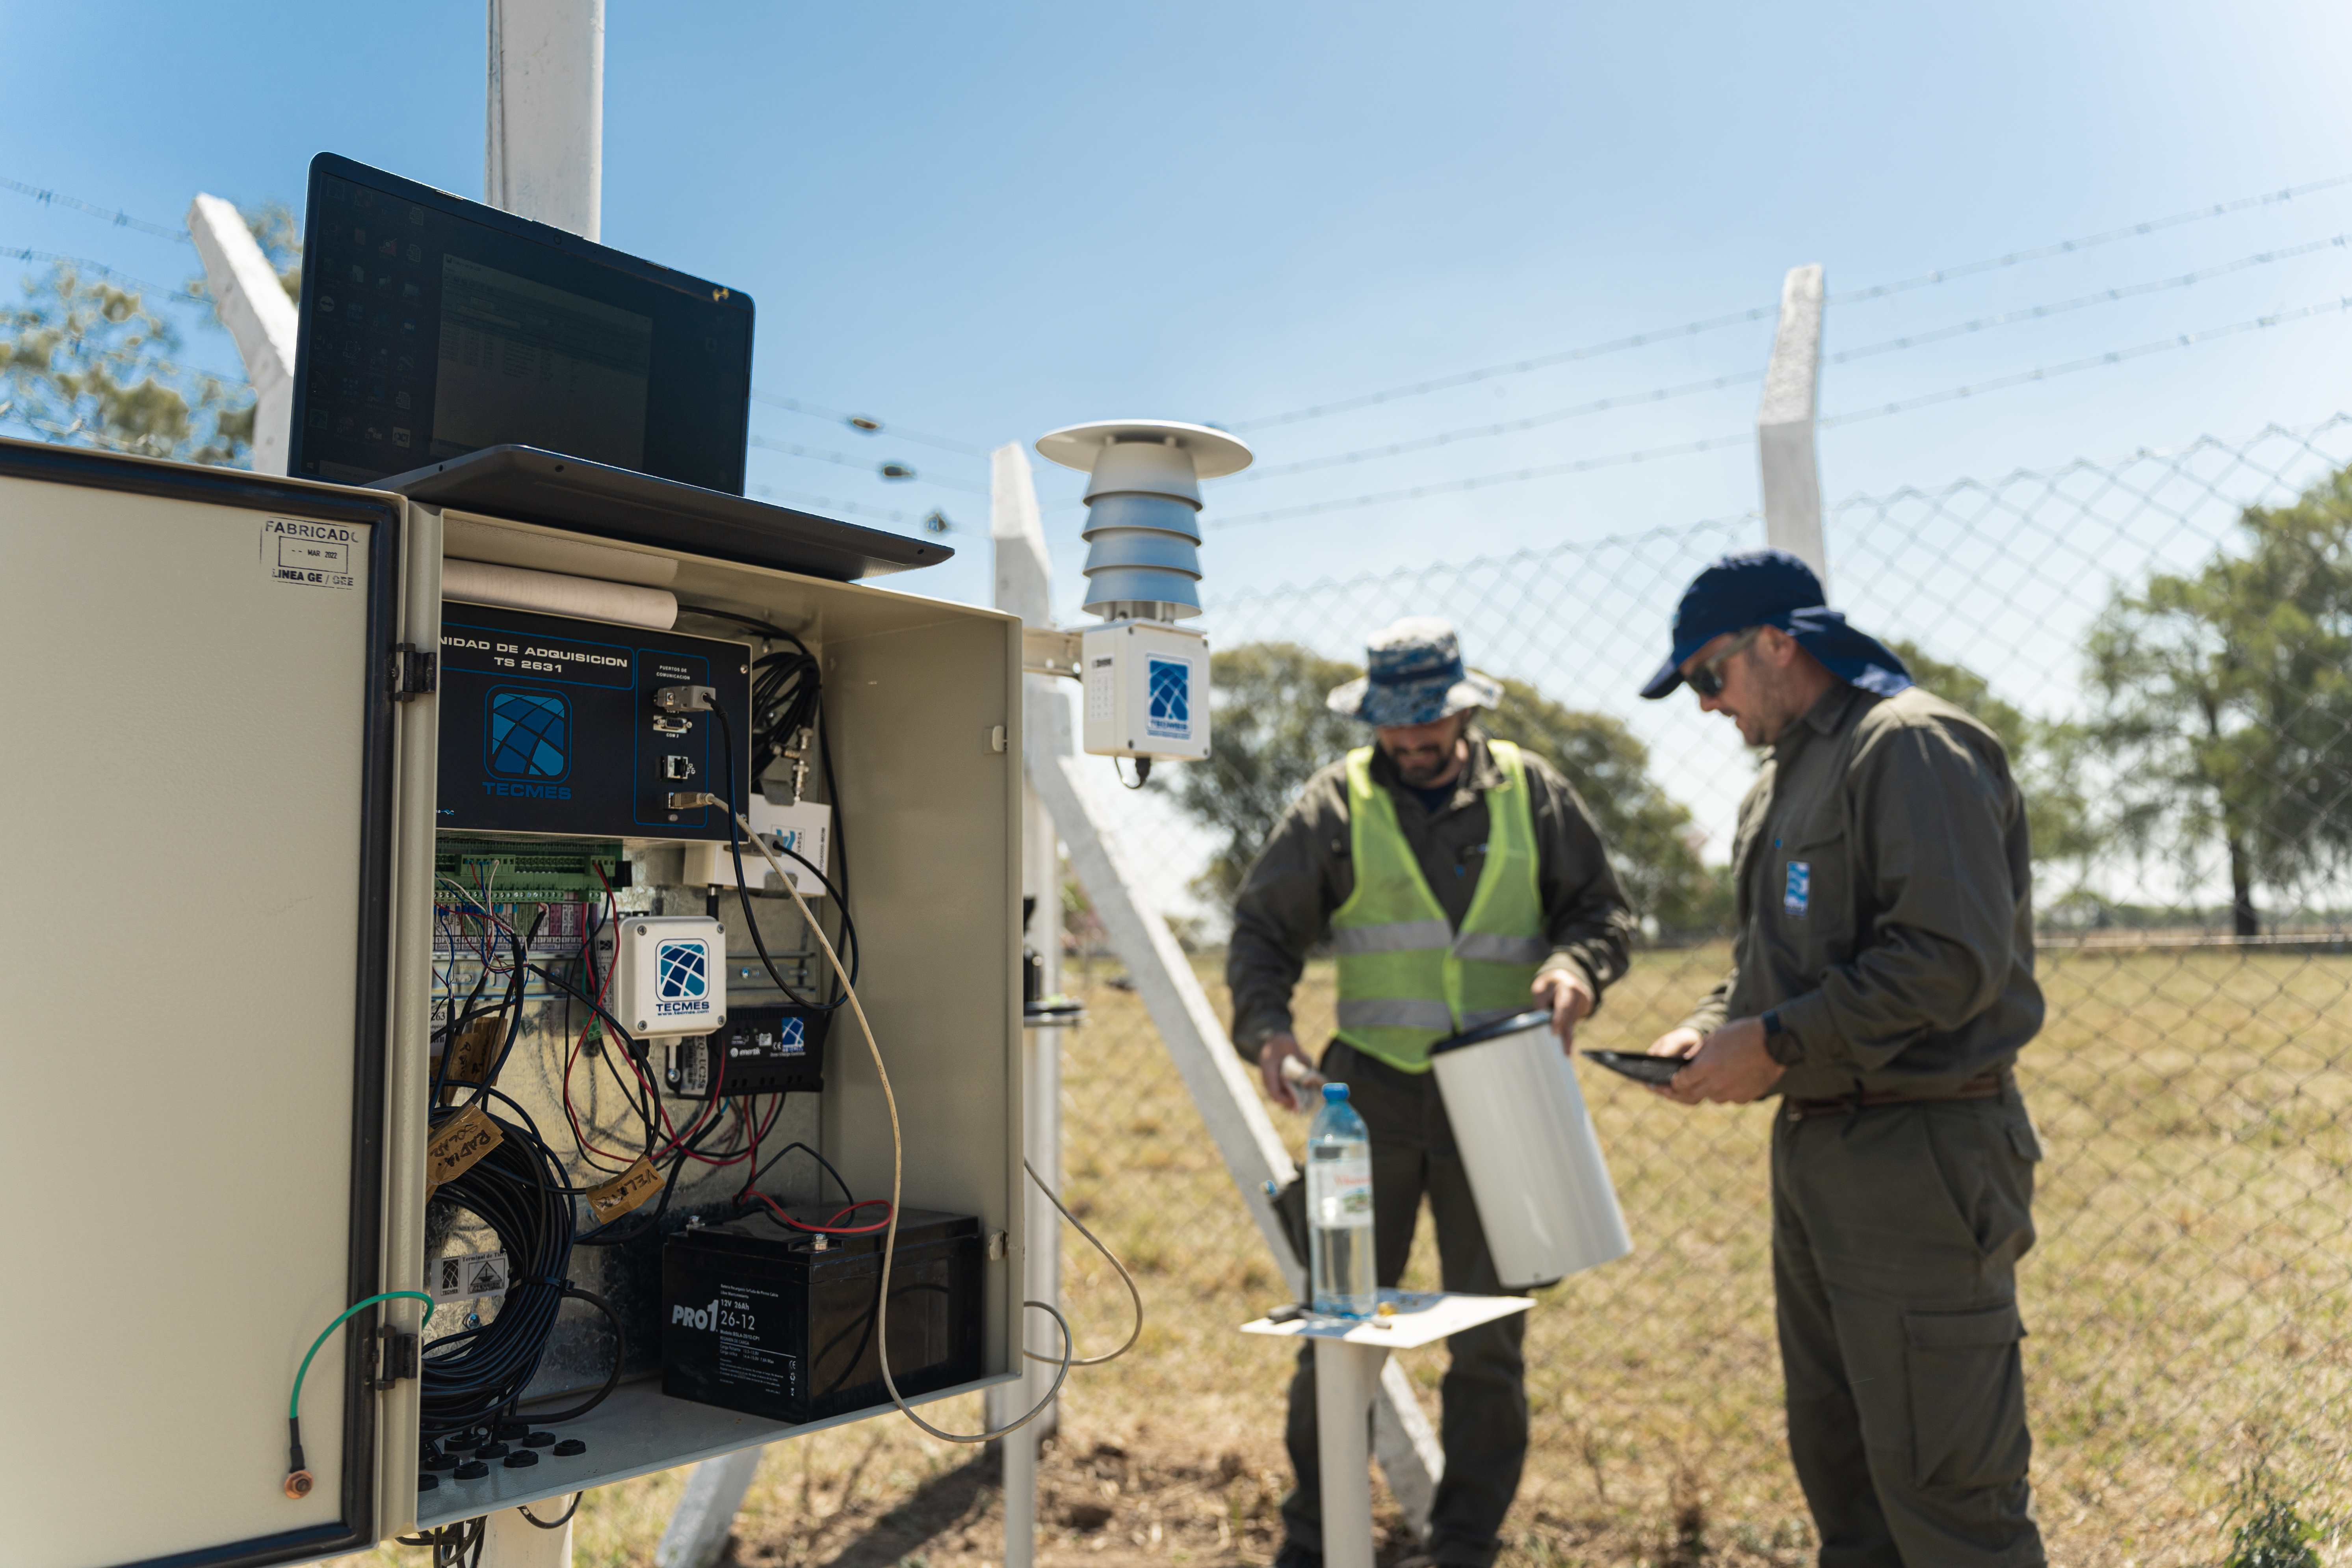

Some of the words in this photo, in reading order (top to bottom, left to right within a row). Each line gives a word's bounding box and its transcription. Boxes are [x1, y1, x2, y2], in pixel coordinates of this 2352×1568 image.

[272, 568, 304, 581] LINEA
[307, 572, 323, 583] GE
[440, 637, 490, 650] NIDAD
[497, 643, 518, 654] DE
[525, 647, 628, 668] ADQUISICION
[494, 657, 515, 667] TS
[521, 660, 562, 673] 2631
[656, 672, 690, 680] COMUNICACION
[482, 781, 572, 801] TECMES
[656, 1001, 710, 1012] TECMES
[698, 1036, 705, 1050] EQ
[739, 1046, 761, 1056] enertik
[721, 1299, 732, 1307] 12V
[734, 1301, 749, 1310] 26Ah
[721, 1310, 755, 1330] 26-12
